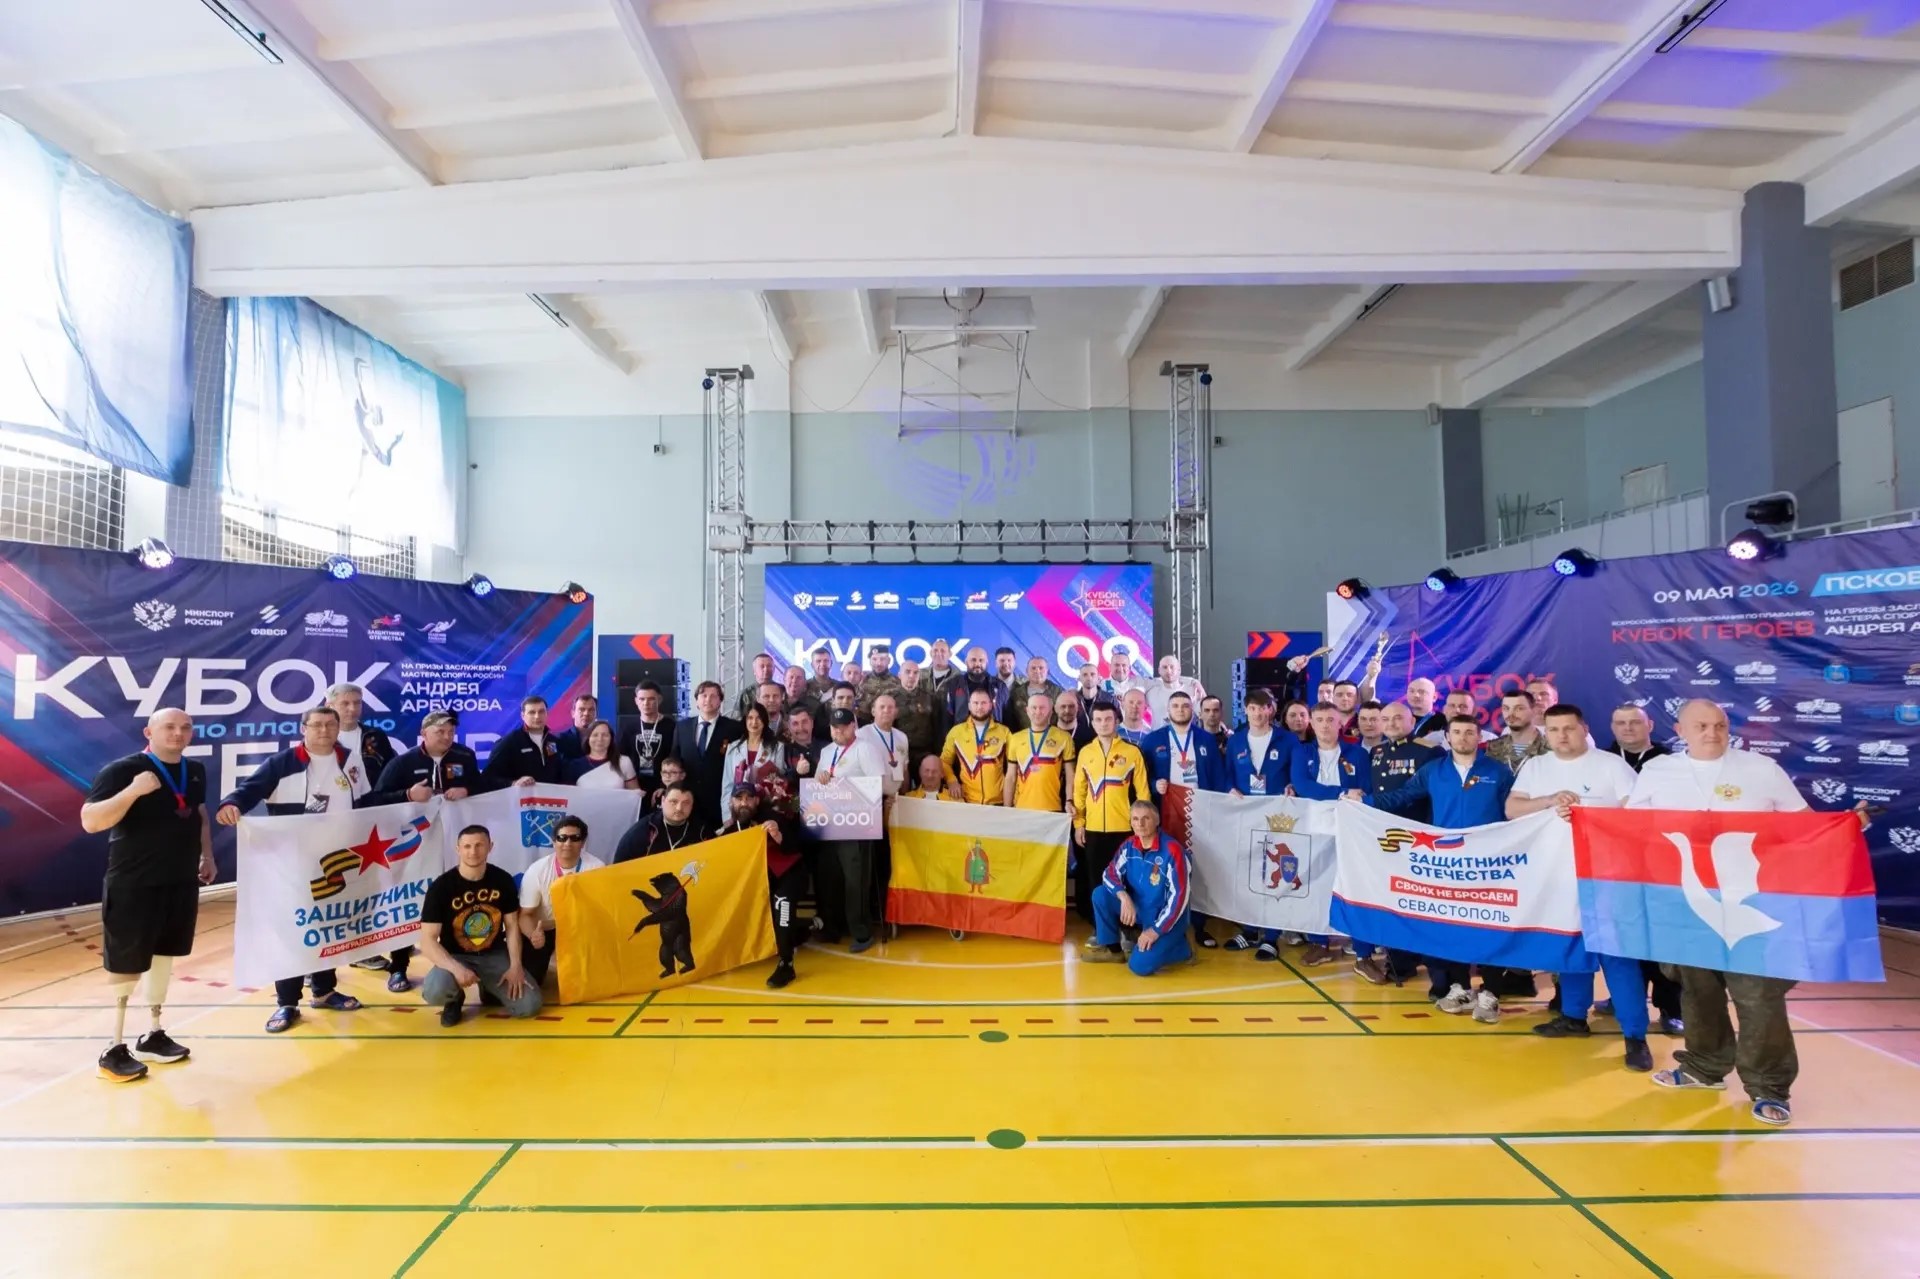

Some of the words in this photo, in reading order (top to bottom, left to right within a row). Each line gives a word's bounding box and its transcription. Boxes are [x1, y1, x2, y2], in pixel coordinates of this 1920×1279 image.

[1653, 590, 1681, 603] 09
[1685, 586, 1734, 601] МАЯ
[1738, 581, 1799, 598] 2026
[184, 609, 235, 618] МИНСПОРТ
[184, 618, 223, 626] РОССИИ
[1825, 622, 1906, 636] АНДРЕЯ
[1611, 624, 1696, 643] КУБОК
[1702, 620, 1816, 640] ГЕРОЕВ
[14, 654, 391, 720] КУБОК
[400, 682, 480, 697] АНДРЕЯ
[400, 699, 503, 712] АРБУЗОВА
[806, 813, 829, 826] 20
[833, 812, 870, 826] 000
[1408, 852, 1528, 869] ЗАЩИТНИКИ
[1410, 865, 1516, 881] ОТЕЧЕСТВА
[451, 888, 501, 910] СССР
[1395, 879, 1435, 895] СВОИХ
[1436, 889, 1453, 898] НЕ
[1454, 890, 1515, 903] БРОСАЕМ
[1398, 898, 1511, 923] СЕВАСТОПОЛЬ
[304, 902, 420, 947] ОТЕЧЕСТВ
[384, 922, 421, 937] ОБЛАСТЬ
